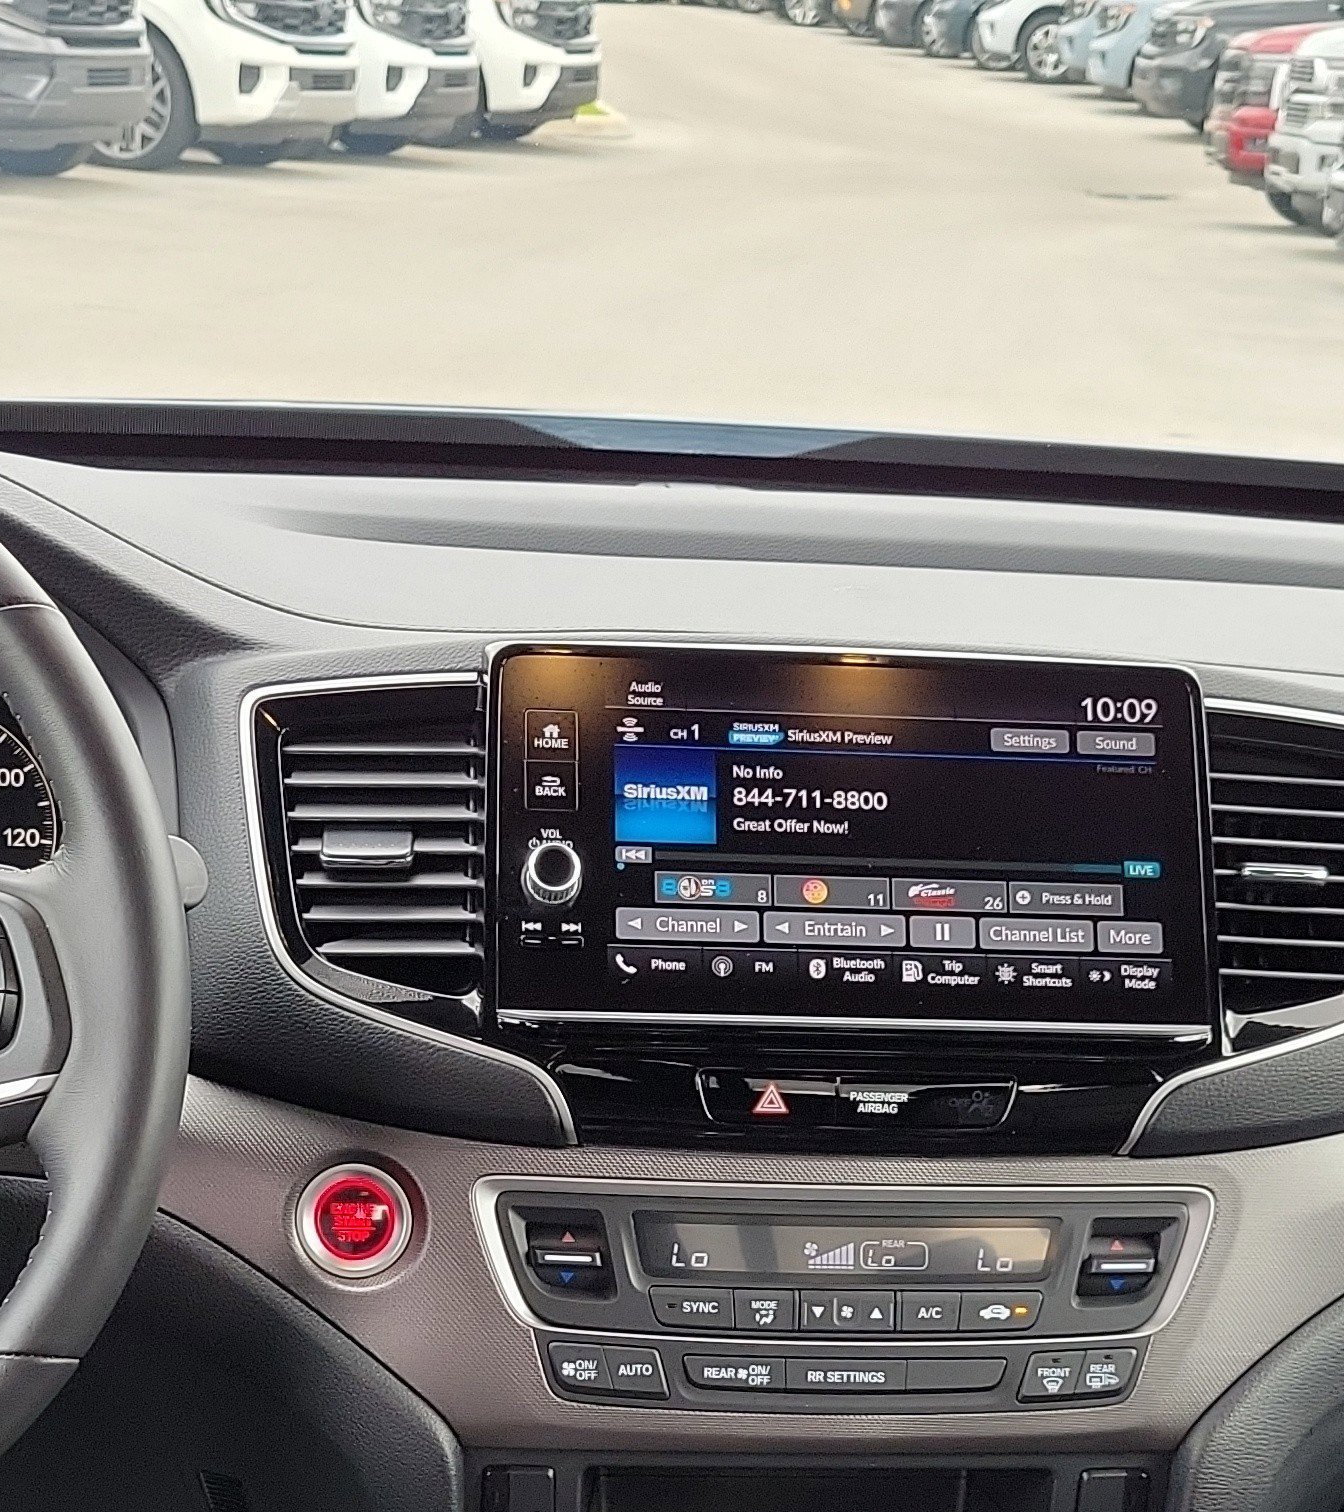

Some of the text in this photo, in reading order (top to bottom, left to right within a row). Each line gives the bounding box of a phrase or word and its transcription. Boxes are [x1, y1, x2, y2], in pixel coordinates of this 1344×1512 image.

[630, 681, 661, 692] Audio
[628, 695, 663, 706] Source
[1081, 697, 1157, 723] 10:09
[670, 724, 699, 740] CH 1
[733, 723, 779, 732] SIRIUSXM
[534, 739, 569, 749] HOME
[788, 730, 893, 746] SiriusXM Preview
[1004, 734, 1057, 750] Settings
[1095, 737, 1137, 751] Sound
[733, 765, 783, 779] No Info
[535, 786, 567, 797] BACK
[623, 784, 708, 801] SiriusXM
[733, 788, 889, 811] 844-711-8800
[733, 818, 849, 834] Great Offer Now!
[2, 828, 40, 848] 120
[540, 828, 562, 839] VOL
[1129, 865, 1154, 875] LIVE
[757, 890, 767, 902] 8
[868, 894, 884, 906] 11
[1042, 893, 1112, 906] Press & Hold
[984, 897, 1003, 910] 26
[656, 917, 721, 933] Channel
[805, 921, 866, 937] Entrtain
[990, 926, 1085, 943] Channel List
[1109, 929, 1152, 945] More
[651, 959, 686, 971] Phone
[755, 962, 773, 973] FM
[833, 958, 885, 970] Bluetooth
[943, 960, 963, 973] Trip
[1031, 962, 1063, 974] Smart
[843, 971, 875, 983] Audio
[1121, 965, 1160, 977] Display
[927, 973, 980, 986] Computer
[1022, 975, 1073, 988] Shortcuts
[1124, 979, 1156, 989] Mode
[850, 1091, 909, 1103] PASSENGER
[857, 1103, 899, 1114] AIRBAG
[334, 1215, 372, 1227] START
[337, 1231, 371, 1242] STOP
[882, 1239, 905, 1248] REAR
[682, 1302, 719, 1313] SYNC
[751, 1301, 778, 1310] MODE
[918, 1307, 943, 1319] A/C
[576, 1370, 599, 1380] OFF
[618, 1364, 653, 1376] AUTO
[704, 1367, 735, 1379] REAR
[1038, 1367, 1070, 1377] FRONT
[1090, 1364, 1115, 1374] REAR
[749, 1375, 771, 1385] OFF
[807, 1370, 885, 1383] RR SETTINGS
